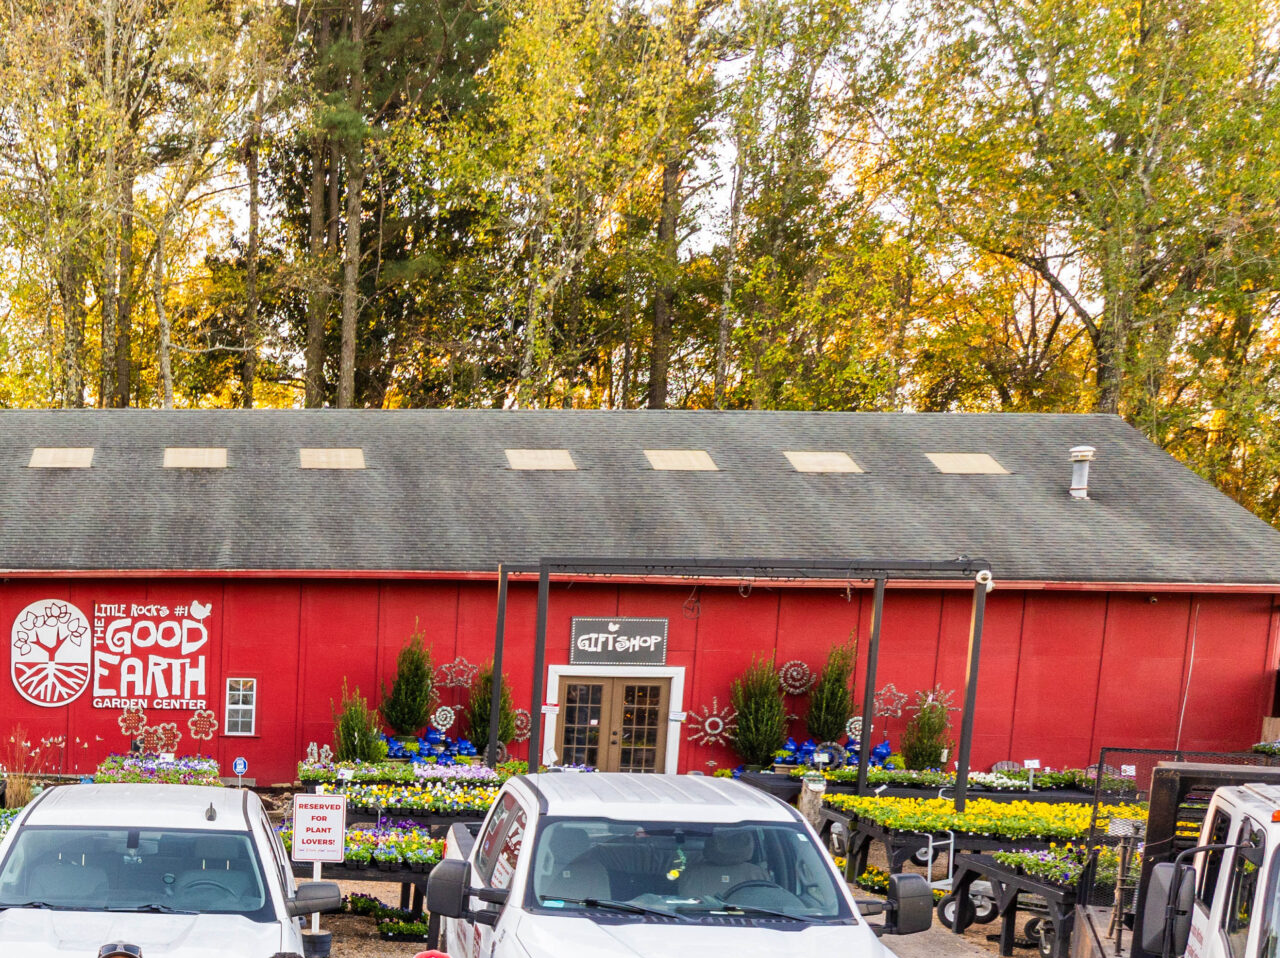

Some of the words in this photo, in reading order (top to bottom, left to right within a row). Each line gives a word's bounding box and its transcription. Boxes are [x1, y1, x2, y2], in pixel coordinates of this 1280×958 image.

[94, 603, 127, 617] LITTLE
[173, 605, 189, 617] #1
[94, 618, 105, 647] THE
[106, 618, 208, 655] GOOD
[577, 633, 617, 652] GIFT
[615, 635, 662, 653] SHOP
[92, 651, 206, 699] EARTH
[93, 698, 148, 709] GARDEN
[153, 698, 207, 710] CENTER
[298, 803, 341, 811] RESERVED
[301, 838, 336, 846] LOVERS!
